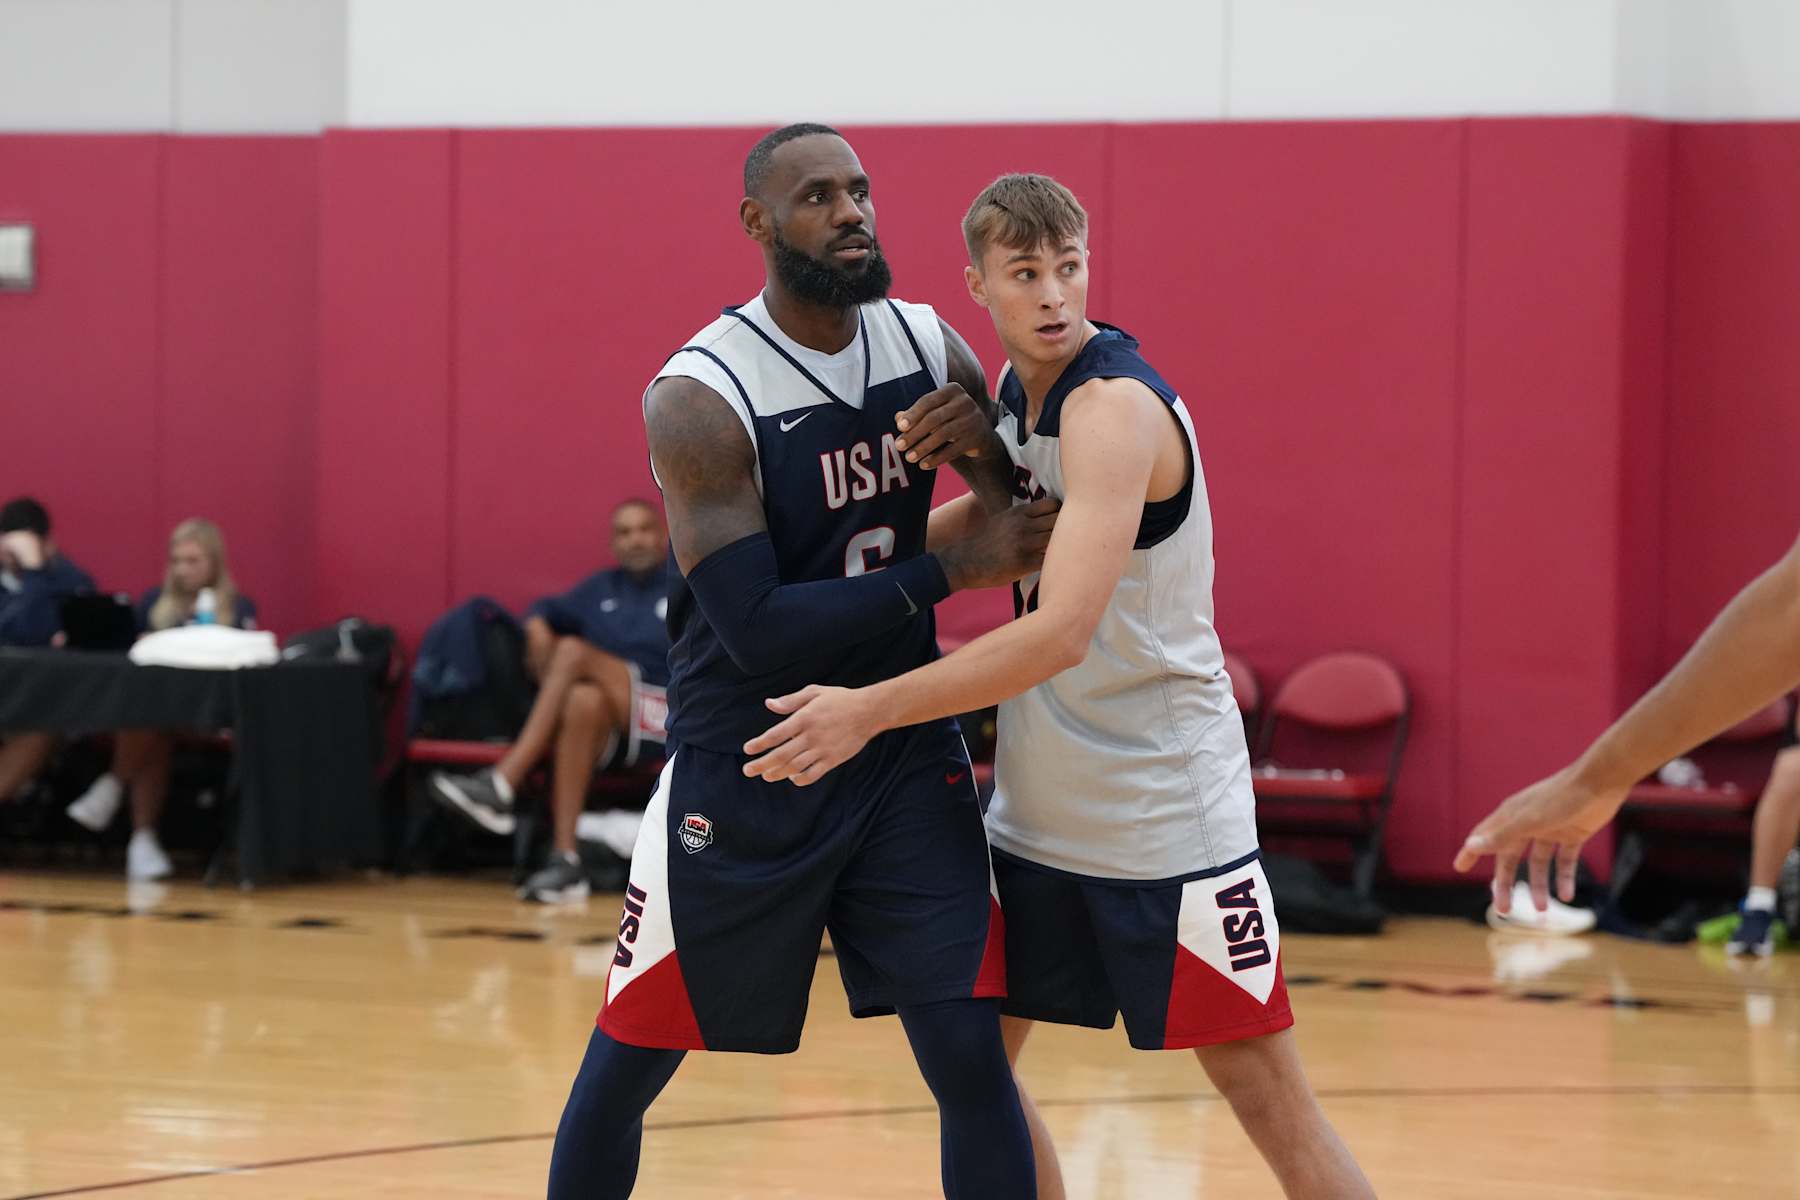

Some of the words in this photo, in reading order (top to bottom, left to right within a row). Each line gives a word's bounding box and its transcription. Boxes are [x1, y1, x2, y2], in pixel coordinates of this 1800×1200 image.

[820, 432, 910, 510] USA
[687, 818, 707, 834] USA
[1215, 877, 1271, 972] USA
